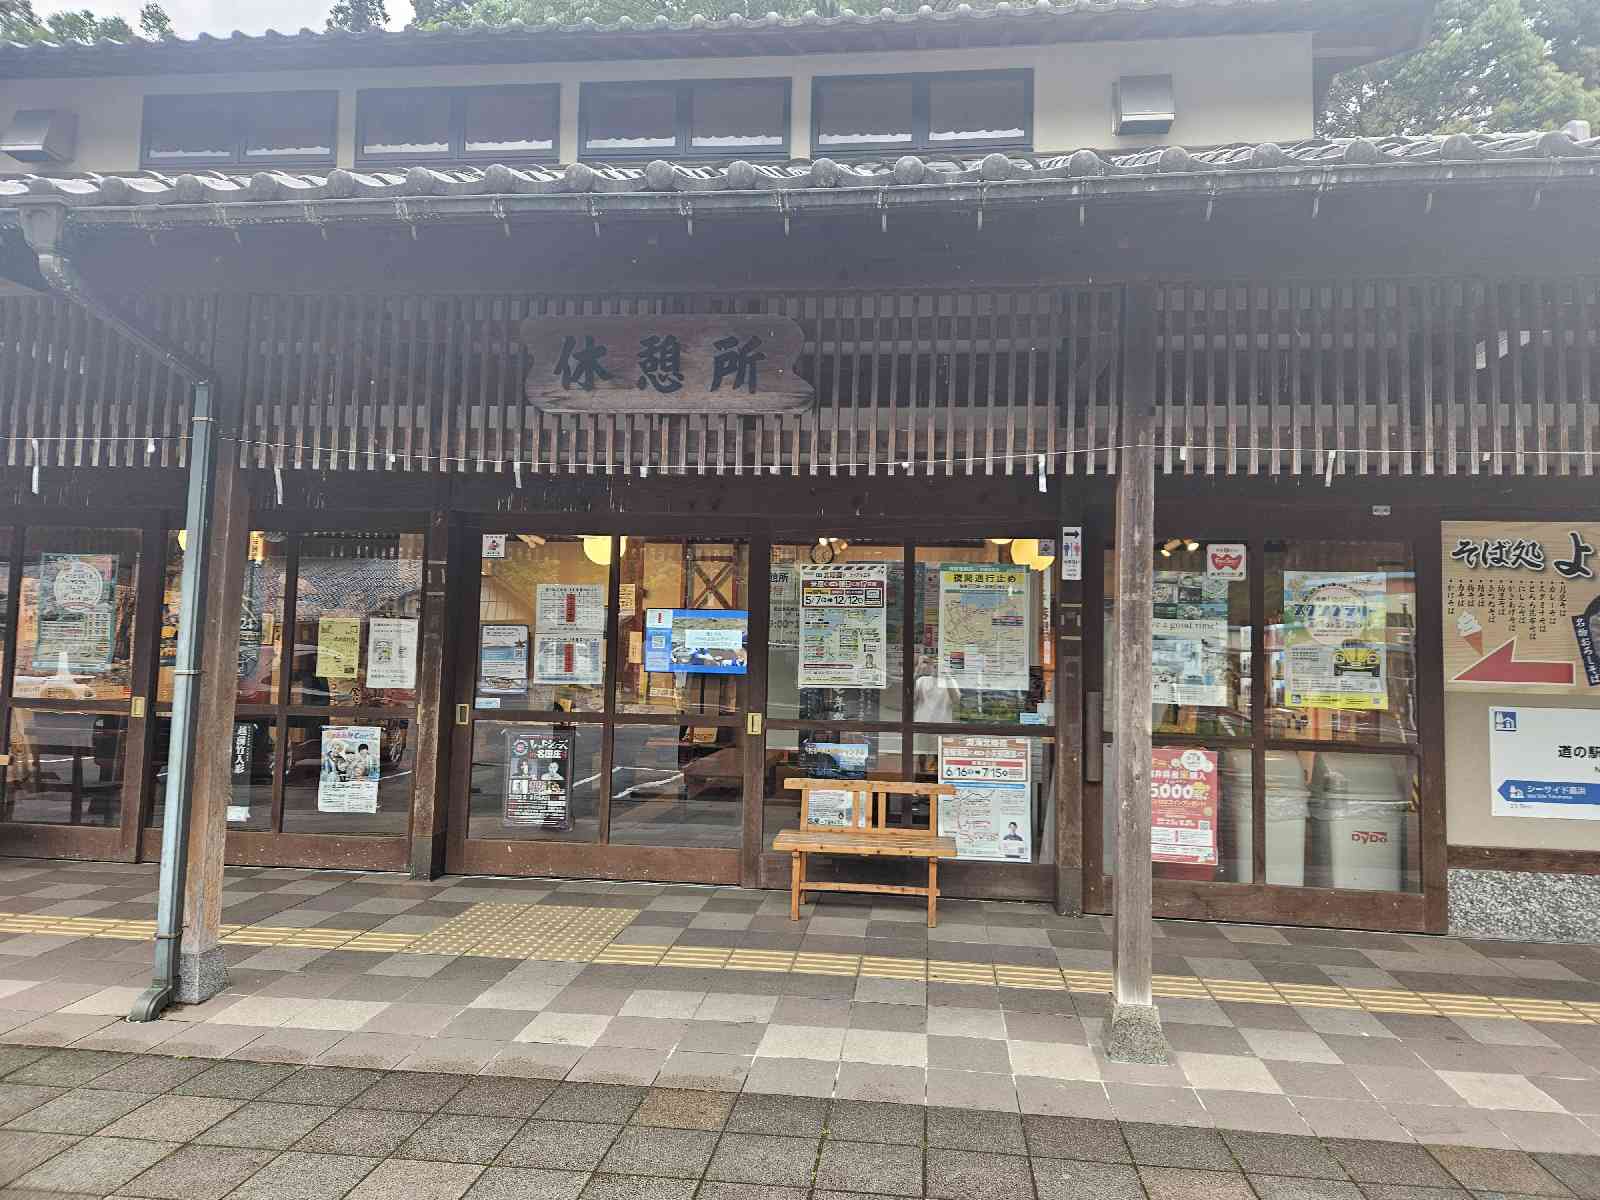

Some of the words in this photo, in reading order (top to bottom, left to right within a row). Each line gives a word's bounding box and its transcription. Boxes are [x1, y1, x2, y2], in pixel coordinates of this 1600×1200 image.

[553, 334, 767, 394] 休憩所
[1451, 538, 1544, 570] そば処
[1553, 531, 1593, 577] よ
[1351, 831, 1387, 844] DyDo
